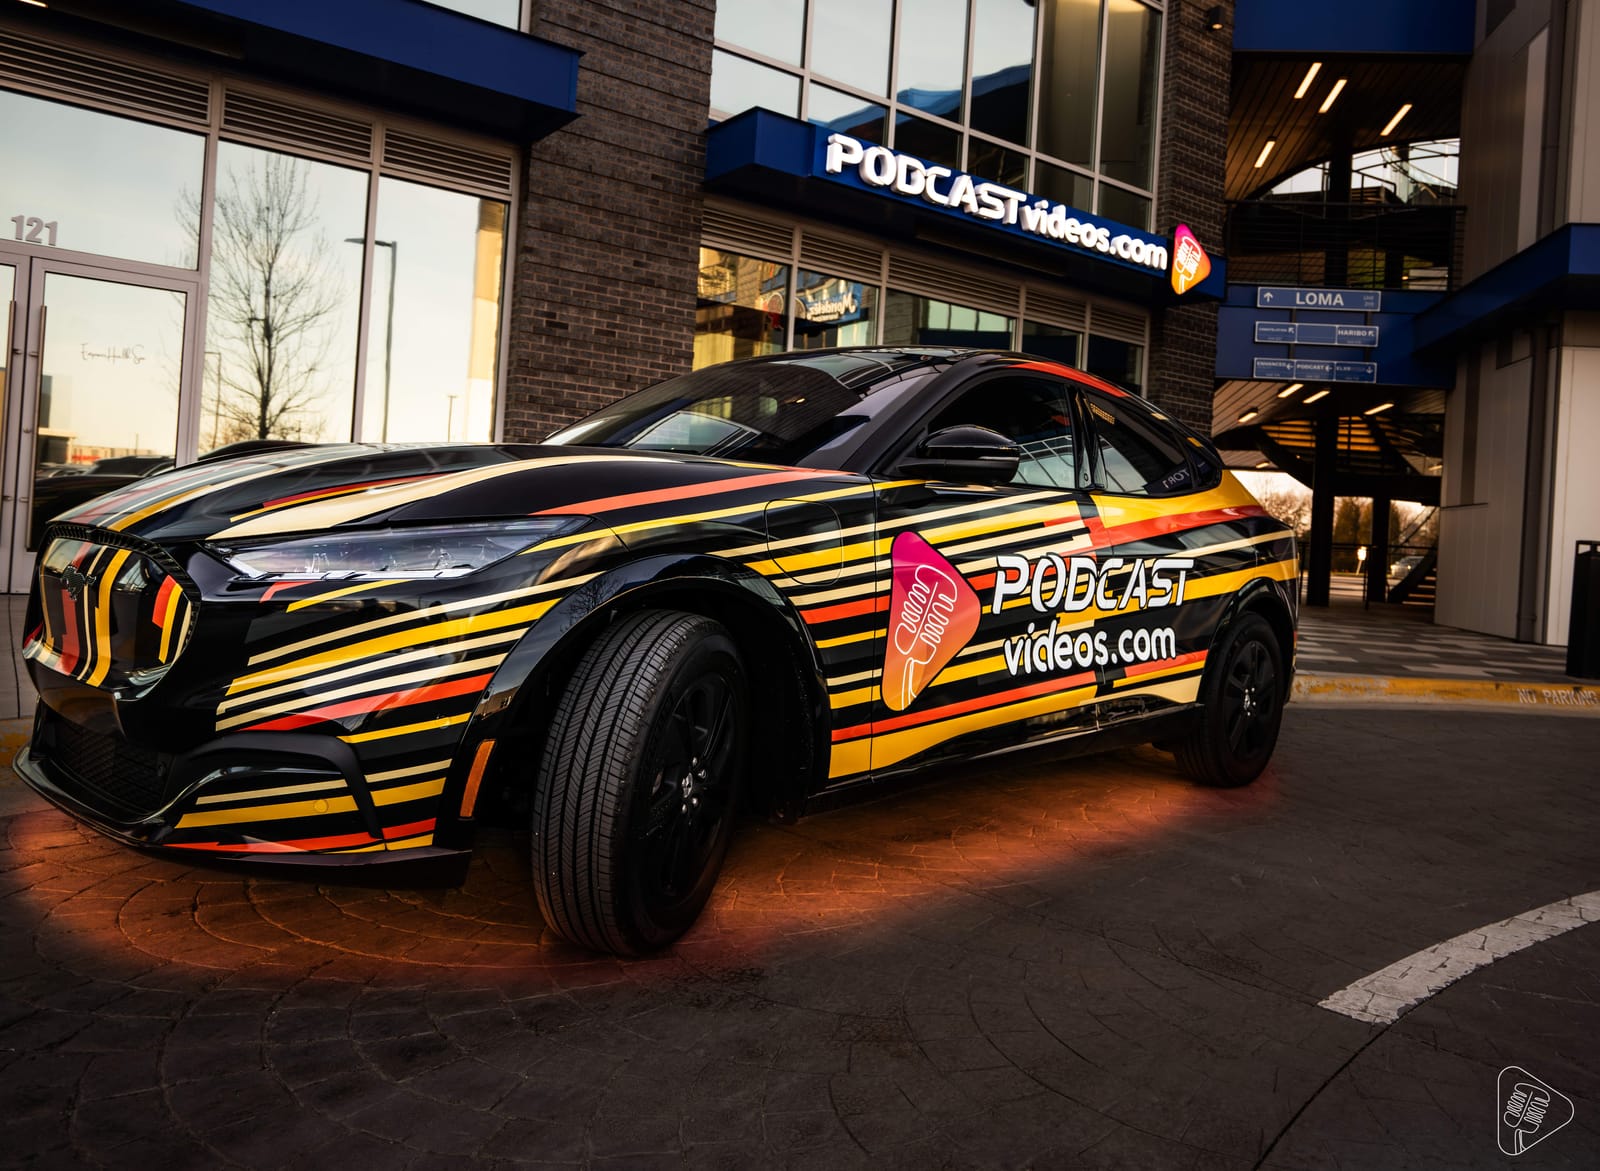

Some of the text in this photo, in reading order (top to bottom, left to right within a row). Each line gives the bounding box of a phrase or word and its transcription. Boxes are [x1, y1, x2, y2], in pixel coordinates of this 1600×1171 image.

[11, 215, 58, 246] 121
[1295, 292, 1344, 306] LOMA
[1337, 329, 1367, 337] HARIBO
[992, 553, 1194, 615] PODCAST
[1004, 620, 1176, 676] videos.com
[1517, 688, 1599, 705] NO PARKING
